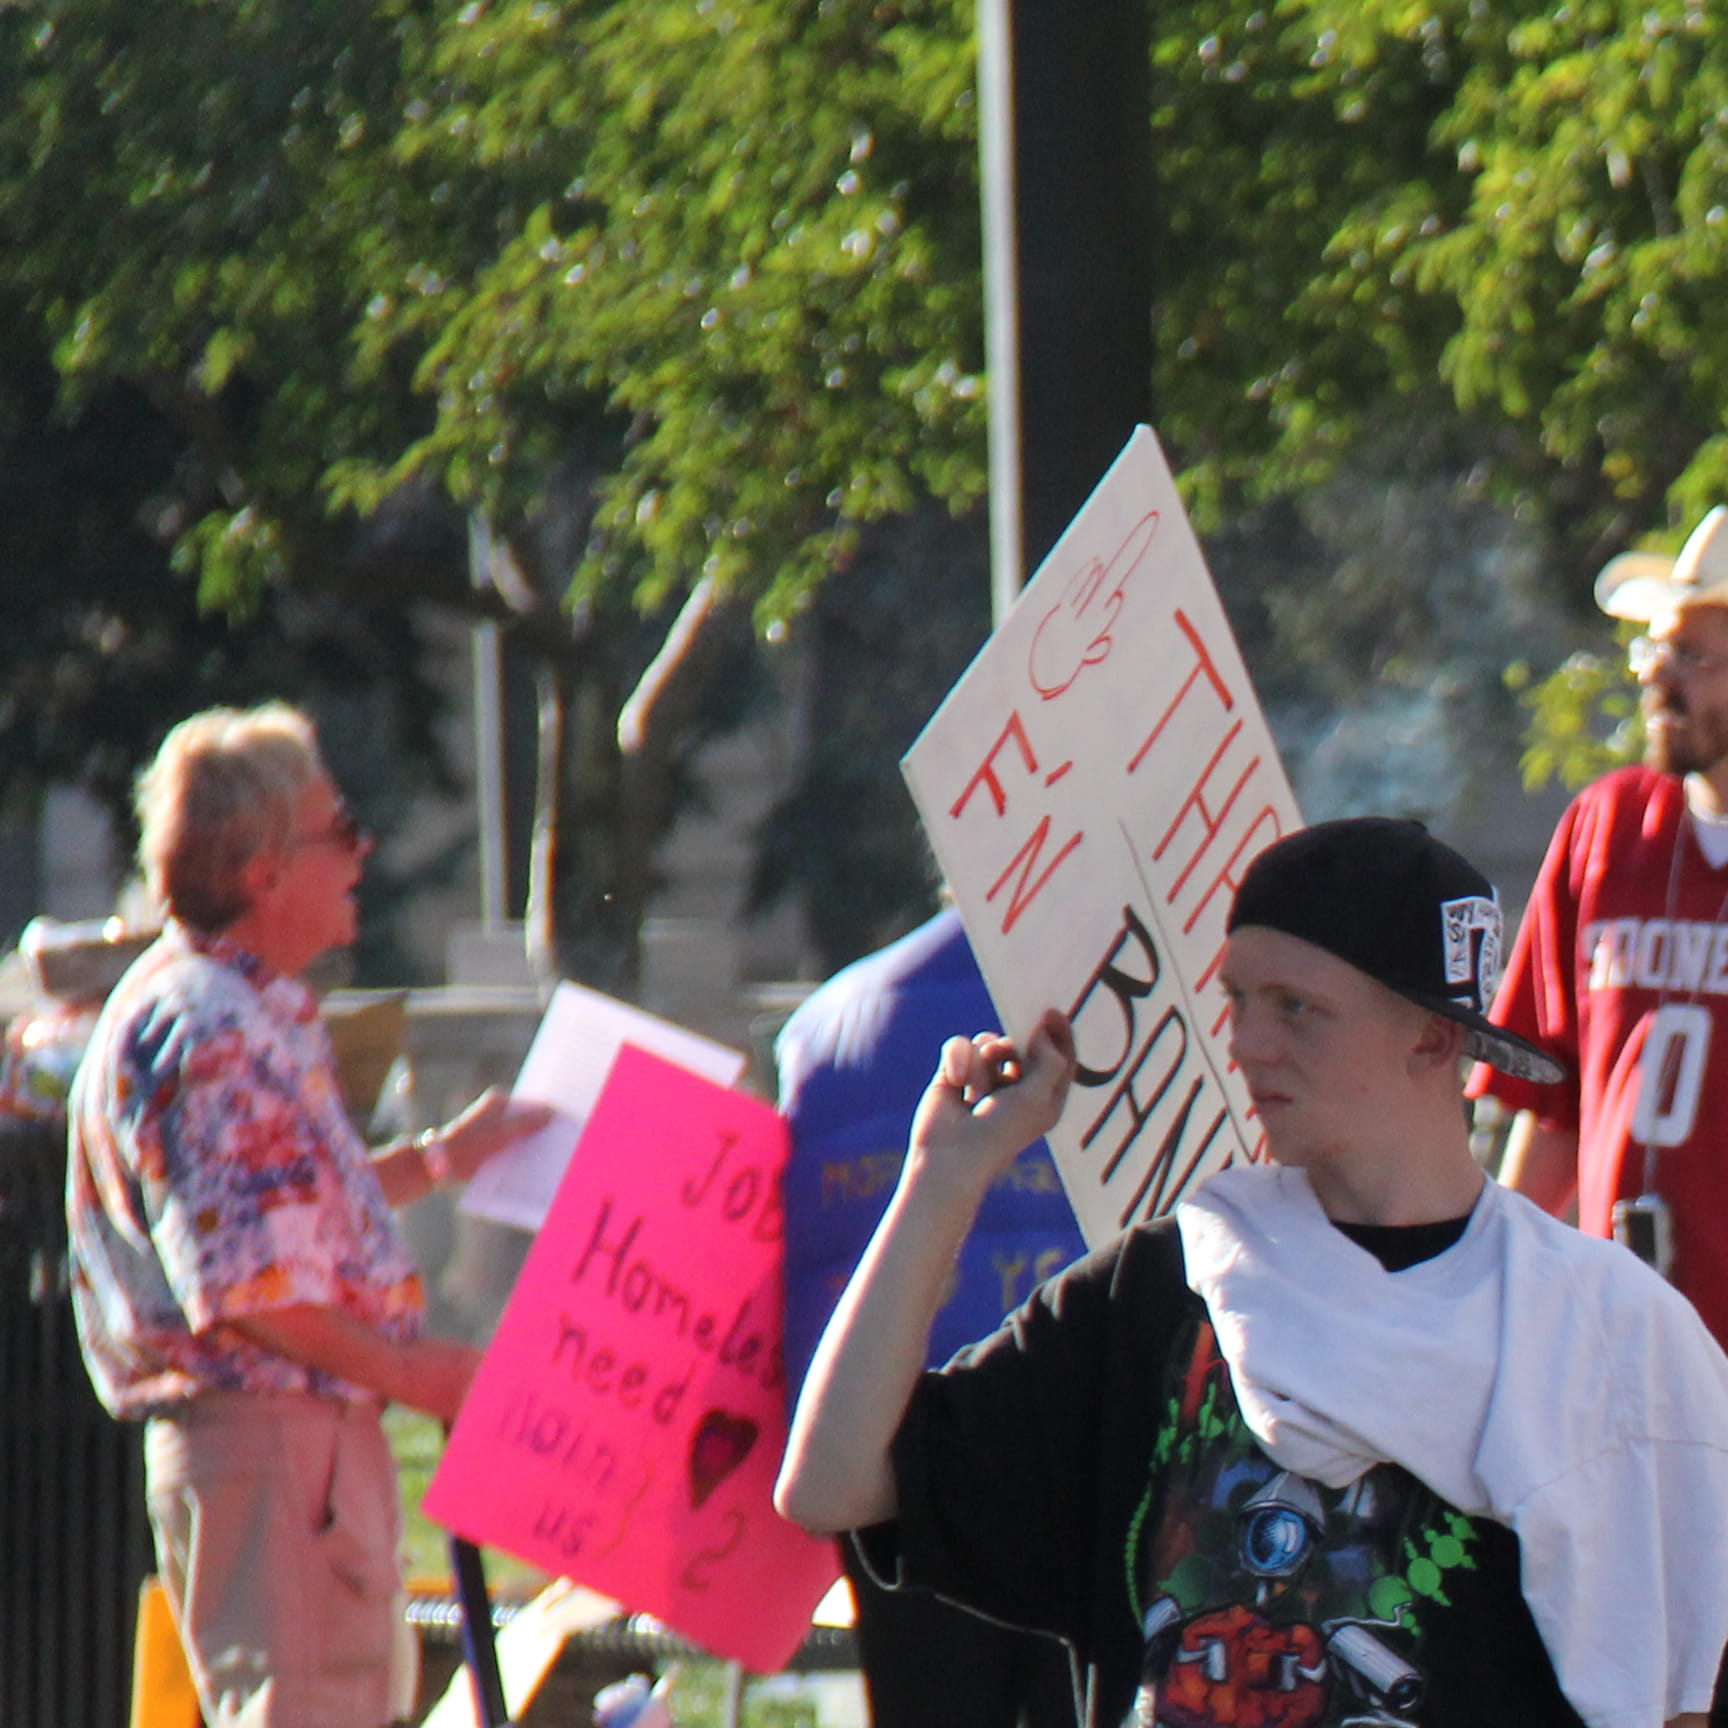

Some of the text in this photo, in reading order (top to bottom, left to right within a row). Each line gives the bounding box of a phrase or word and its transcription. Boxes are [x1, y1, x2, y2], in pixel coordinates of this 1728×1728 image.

[1066, 903, 1238, 1228] BAN
[1631, 1003, 1711, 1147] 0
[552, 1312, 698, 1426] need
